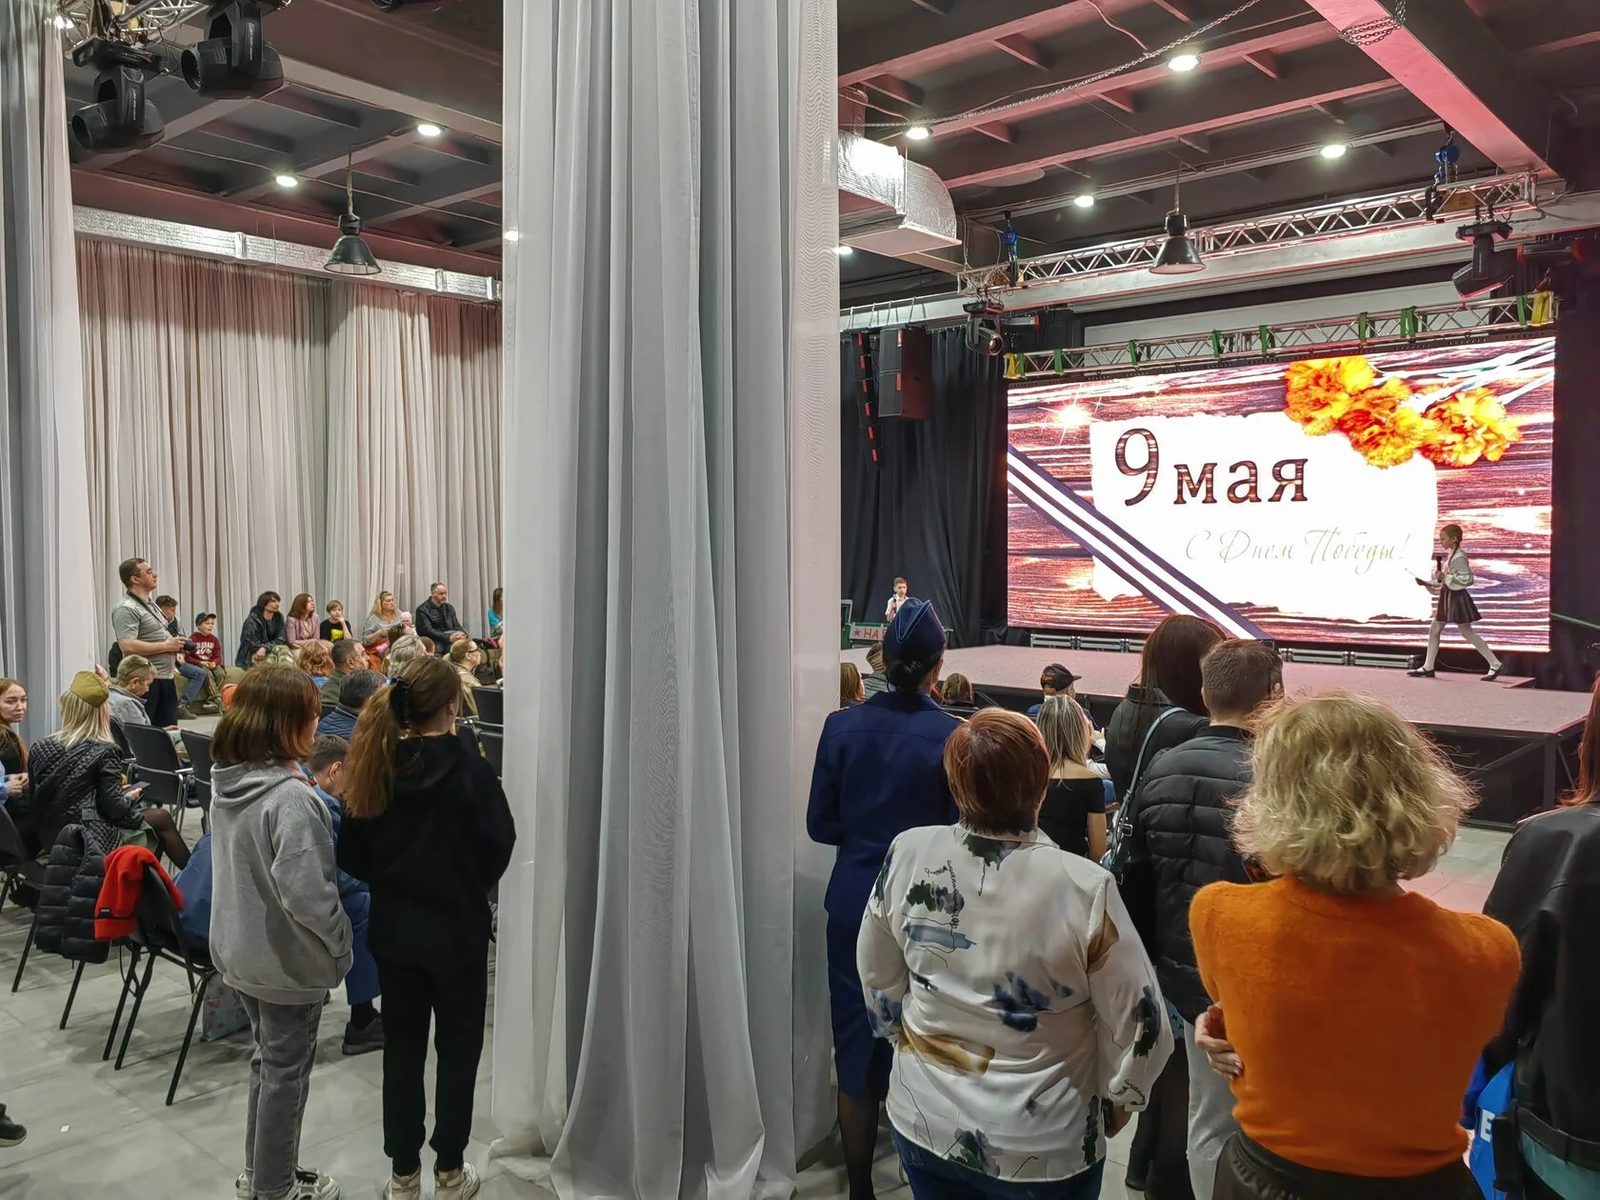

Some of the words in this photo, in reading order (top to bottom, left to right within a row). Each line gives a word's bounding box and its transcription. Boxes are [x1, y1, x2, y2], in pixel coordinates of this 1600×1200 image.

[1115, 428, 1159, 506] 9
[1173, 458, 1309, 505] мая
[1304, 526, 1411, 576] Победы!
